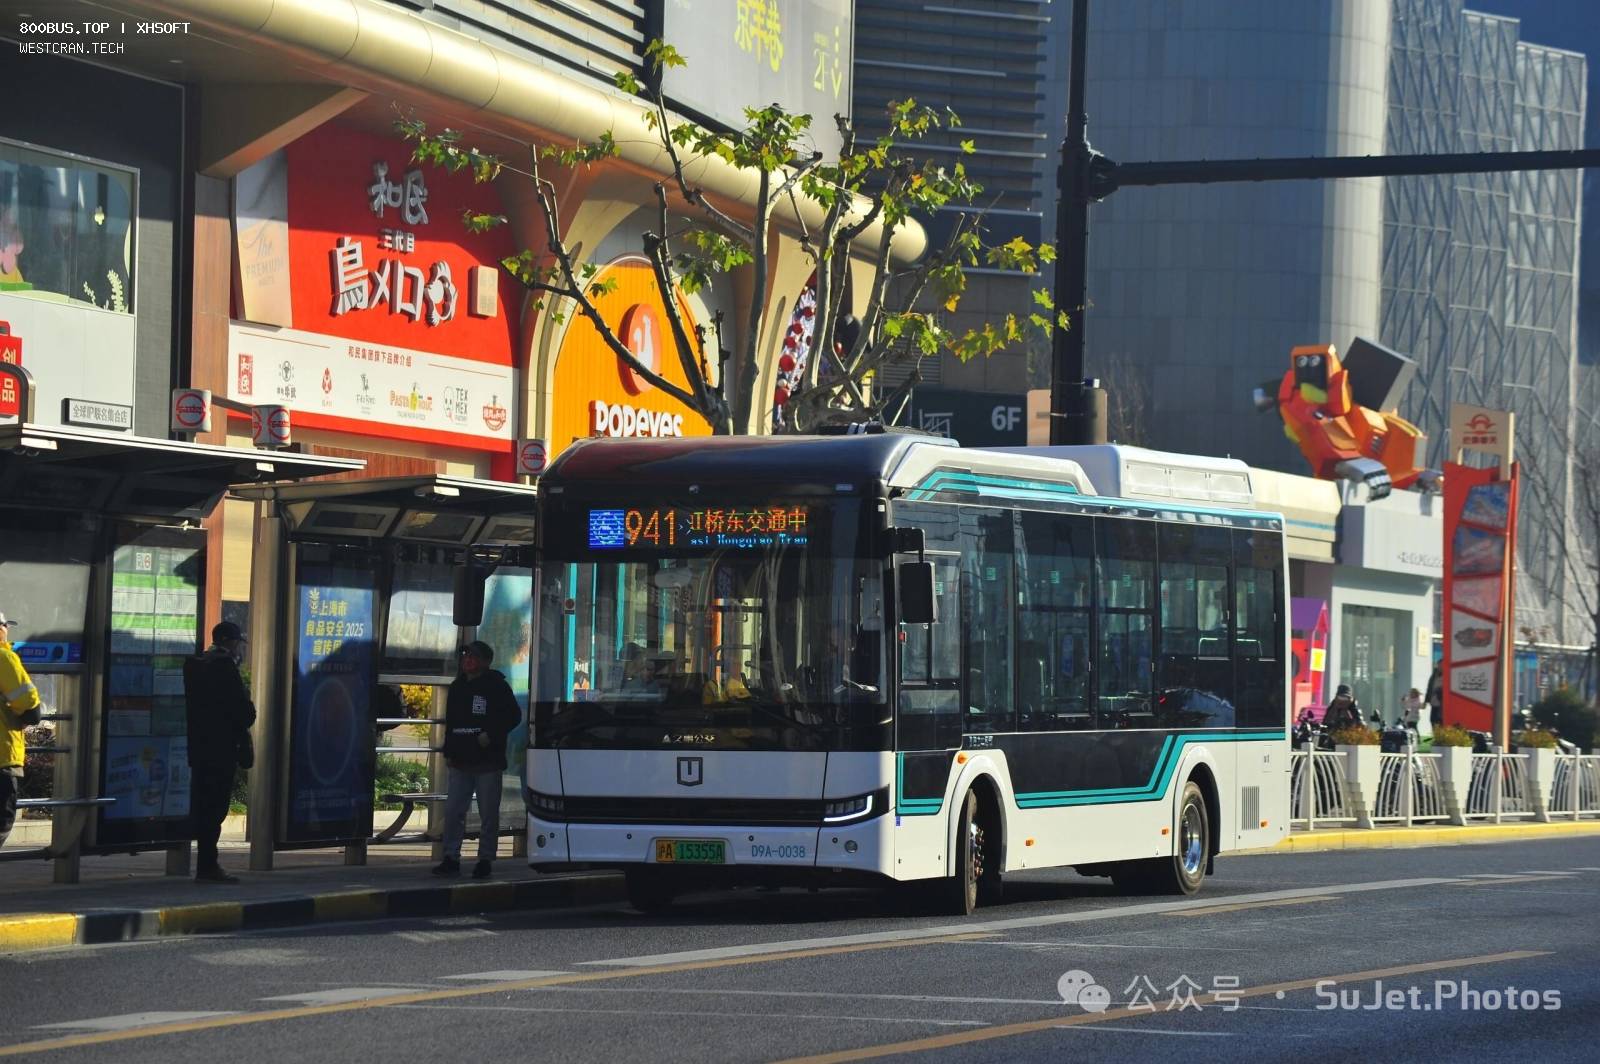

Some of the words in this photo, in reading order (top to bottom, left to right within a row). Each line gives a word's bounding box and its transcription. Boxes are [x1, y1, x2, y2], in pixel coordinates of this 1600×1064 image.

[456, 387, 469, 402] TEX
[991, 405, 1022, 431] 6F
[625, 509, 675, 545] 941
[319, 600, 348, 616] 上海市
[306, 620, 344, 637] 食品安全
[345, 623, 365, 637] 2025
[752, 845, 806, 858] D9A-0038
